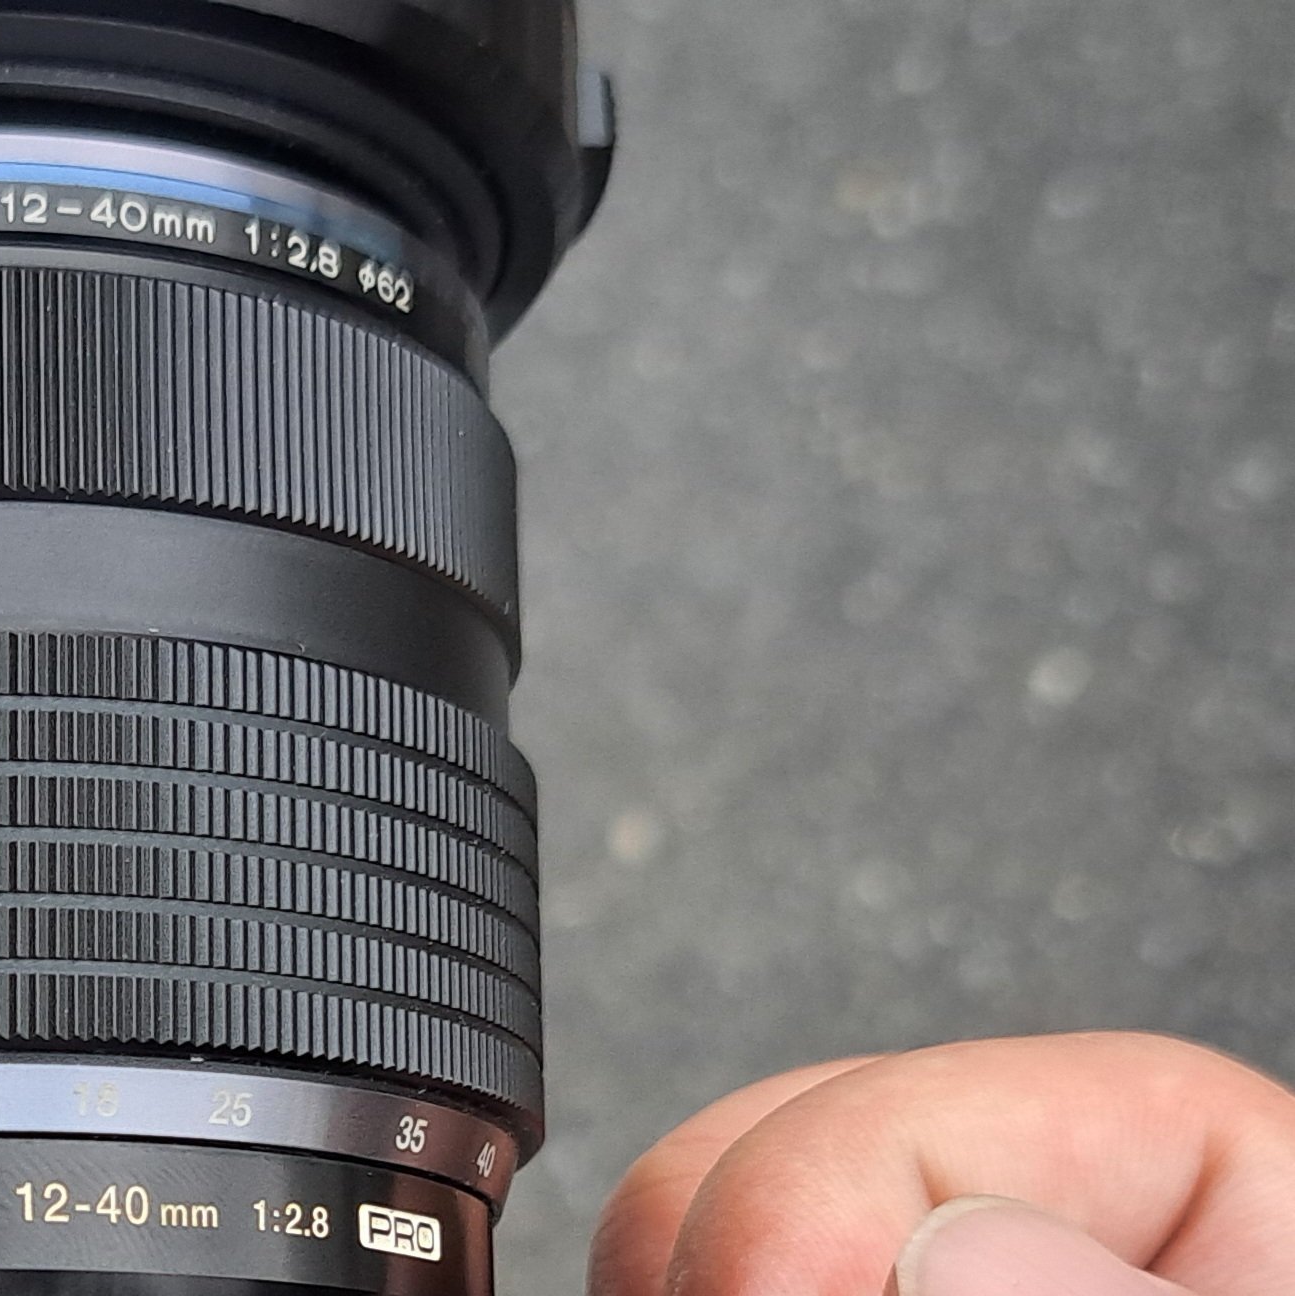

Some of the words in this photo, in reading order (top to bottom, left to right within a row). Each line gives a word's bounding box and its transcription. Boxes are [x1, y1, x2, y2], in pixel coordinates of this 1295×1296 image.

[243, 219, 342, 280] 1:2.8
[208, 1089, 253, 1127] 25
[395, 1115, 428, 1153] 35
[476, 1142, 496, 1178] 40
[252, 1199, 331, 1239] 1:2.8
[366, 1209, 436, 1256] PRO
